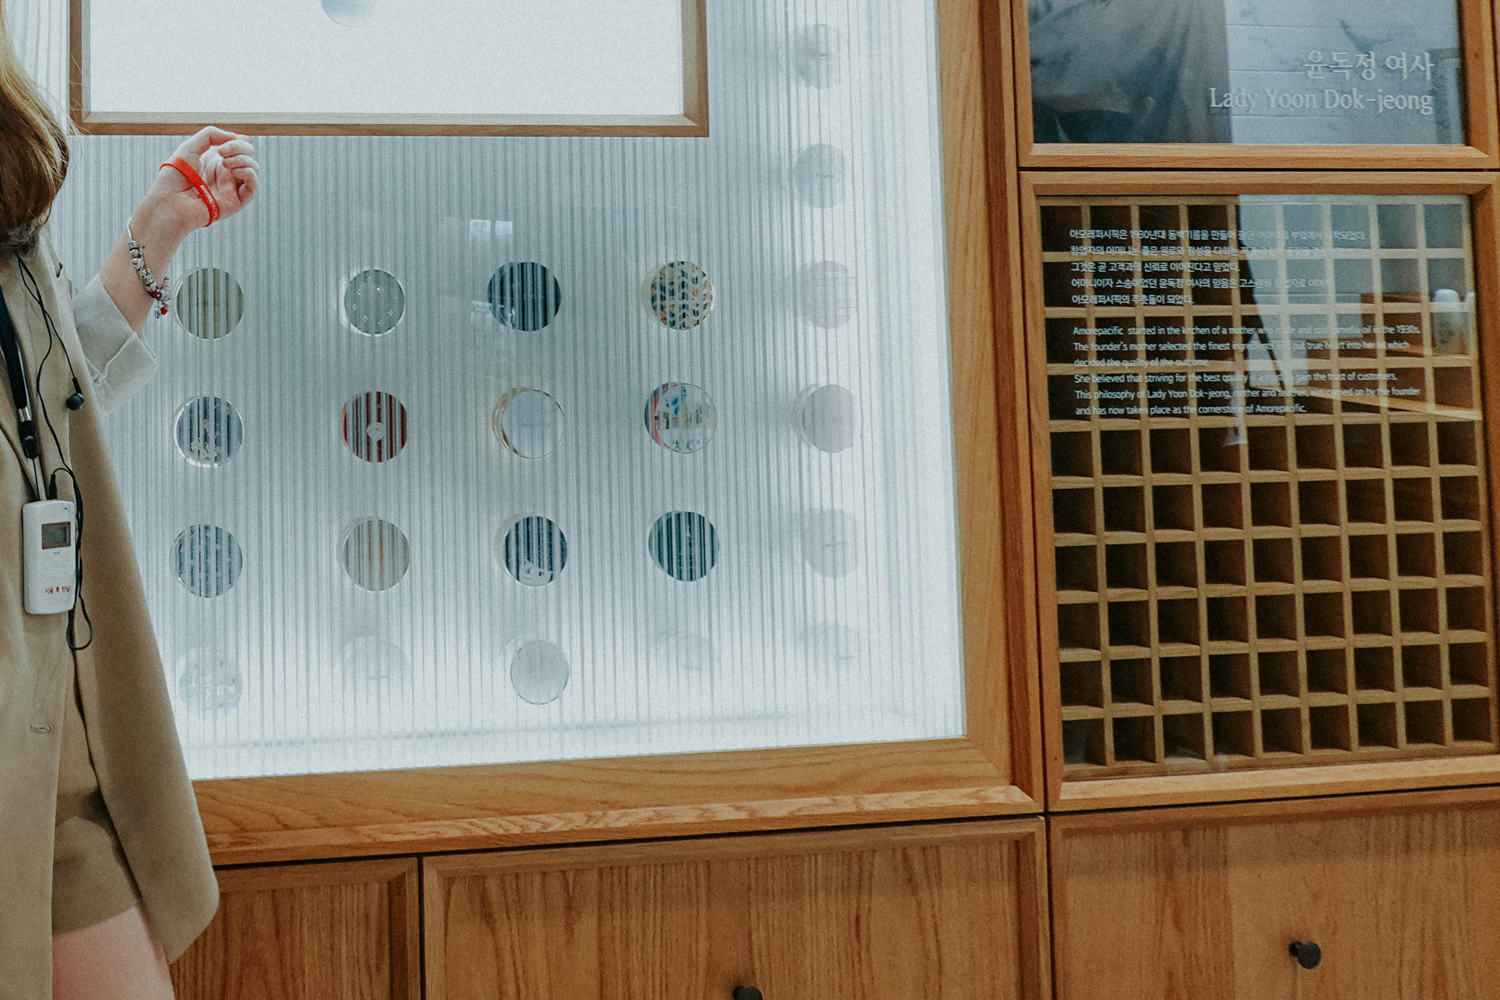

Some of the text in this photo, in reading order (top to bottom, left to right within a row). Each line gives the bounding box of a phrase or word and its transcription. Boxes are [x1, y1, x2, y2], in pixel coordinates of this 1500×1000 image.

[1303, 51, 1435, 81] 윤독정 여사
[1209, 87, 1433, 115] Lady Yoon Dok-jeong
